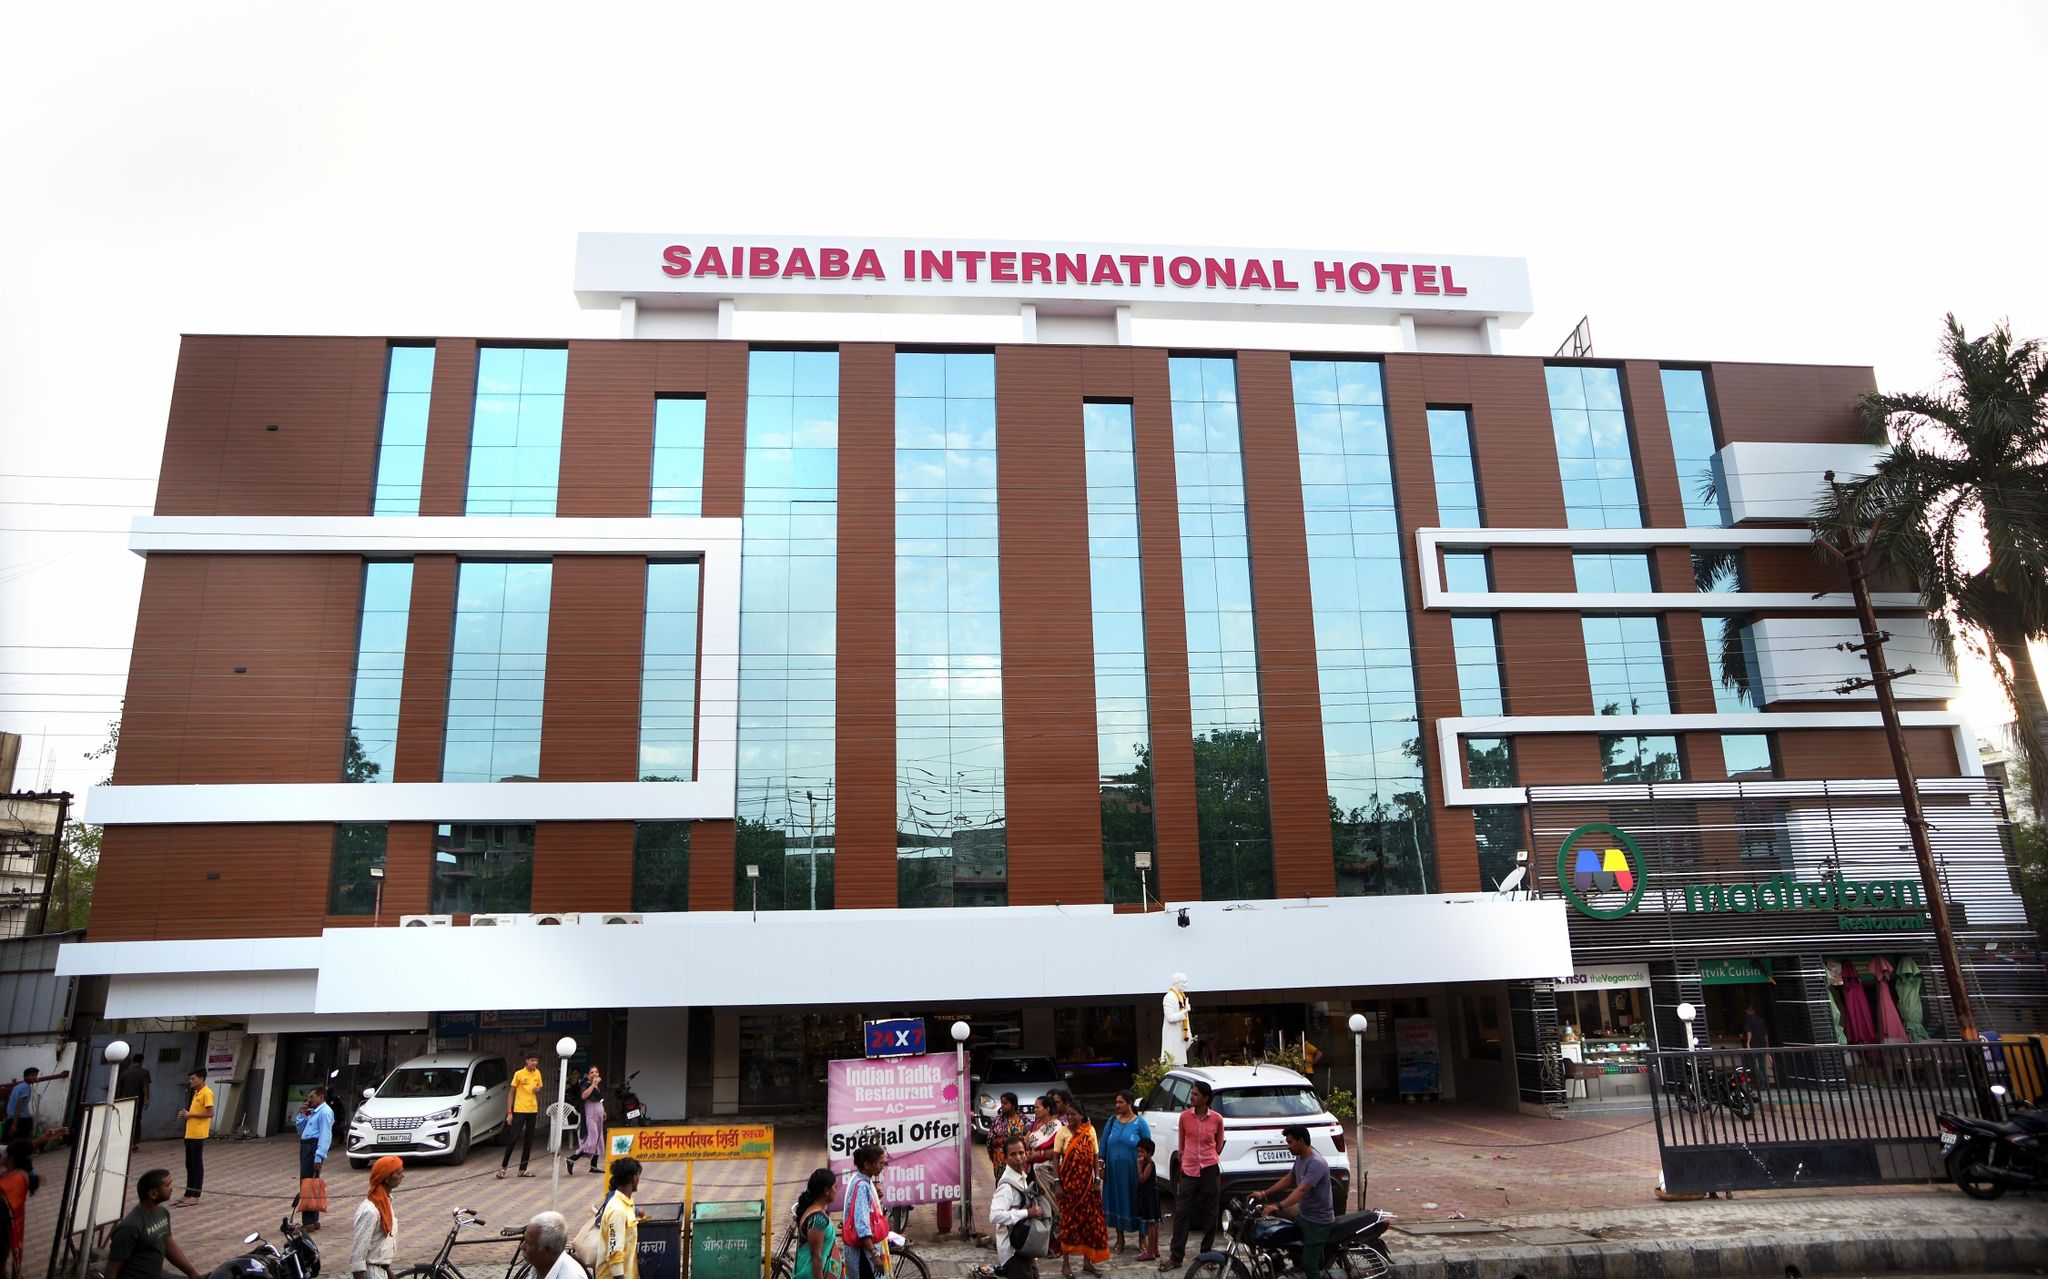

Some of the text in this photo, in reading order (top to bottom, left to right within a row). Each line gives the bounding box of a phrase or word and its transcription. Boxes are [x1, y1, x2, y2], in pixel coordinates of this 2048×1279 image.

[661, 245, 1468, 296] SAIBABA INTERNATIONAL HOTEL
[1685, 871, 1922, 914] madhuban
[1837, 912, 1925, 931] Restaurant
[1728, 966, 1761, 977] Cuisin
[846, 1064, 942, 1087] Indian Tadka
[855, 1085, 934, 1102] Restaurant
[885, 1103, 904, 1114] AC
[638, 1131, 665, 1150] शिर्डी
[831, 1120, 960, 1156] Special Offer
[888, 1165, 925, 1182] Thali
[886, 1182, 961, 1202] Get 1 Free
